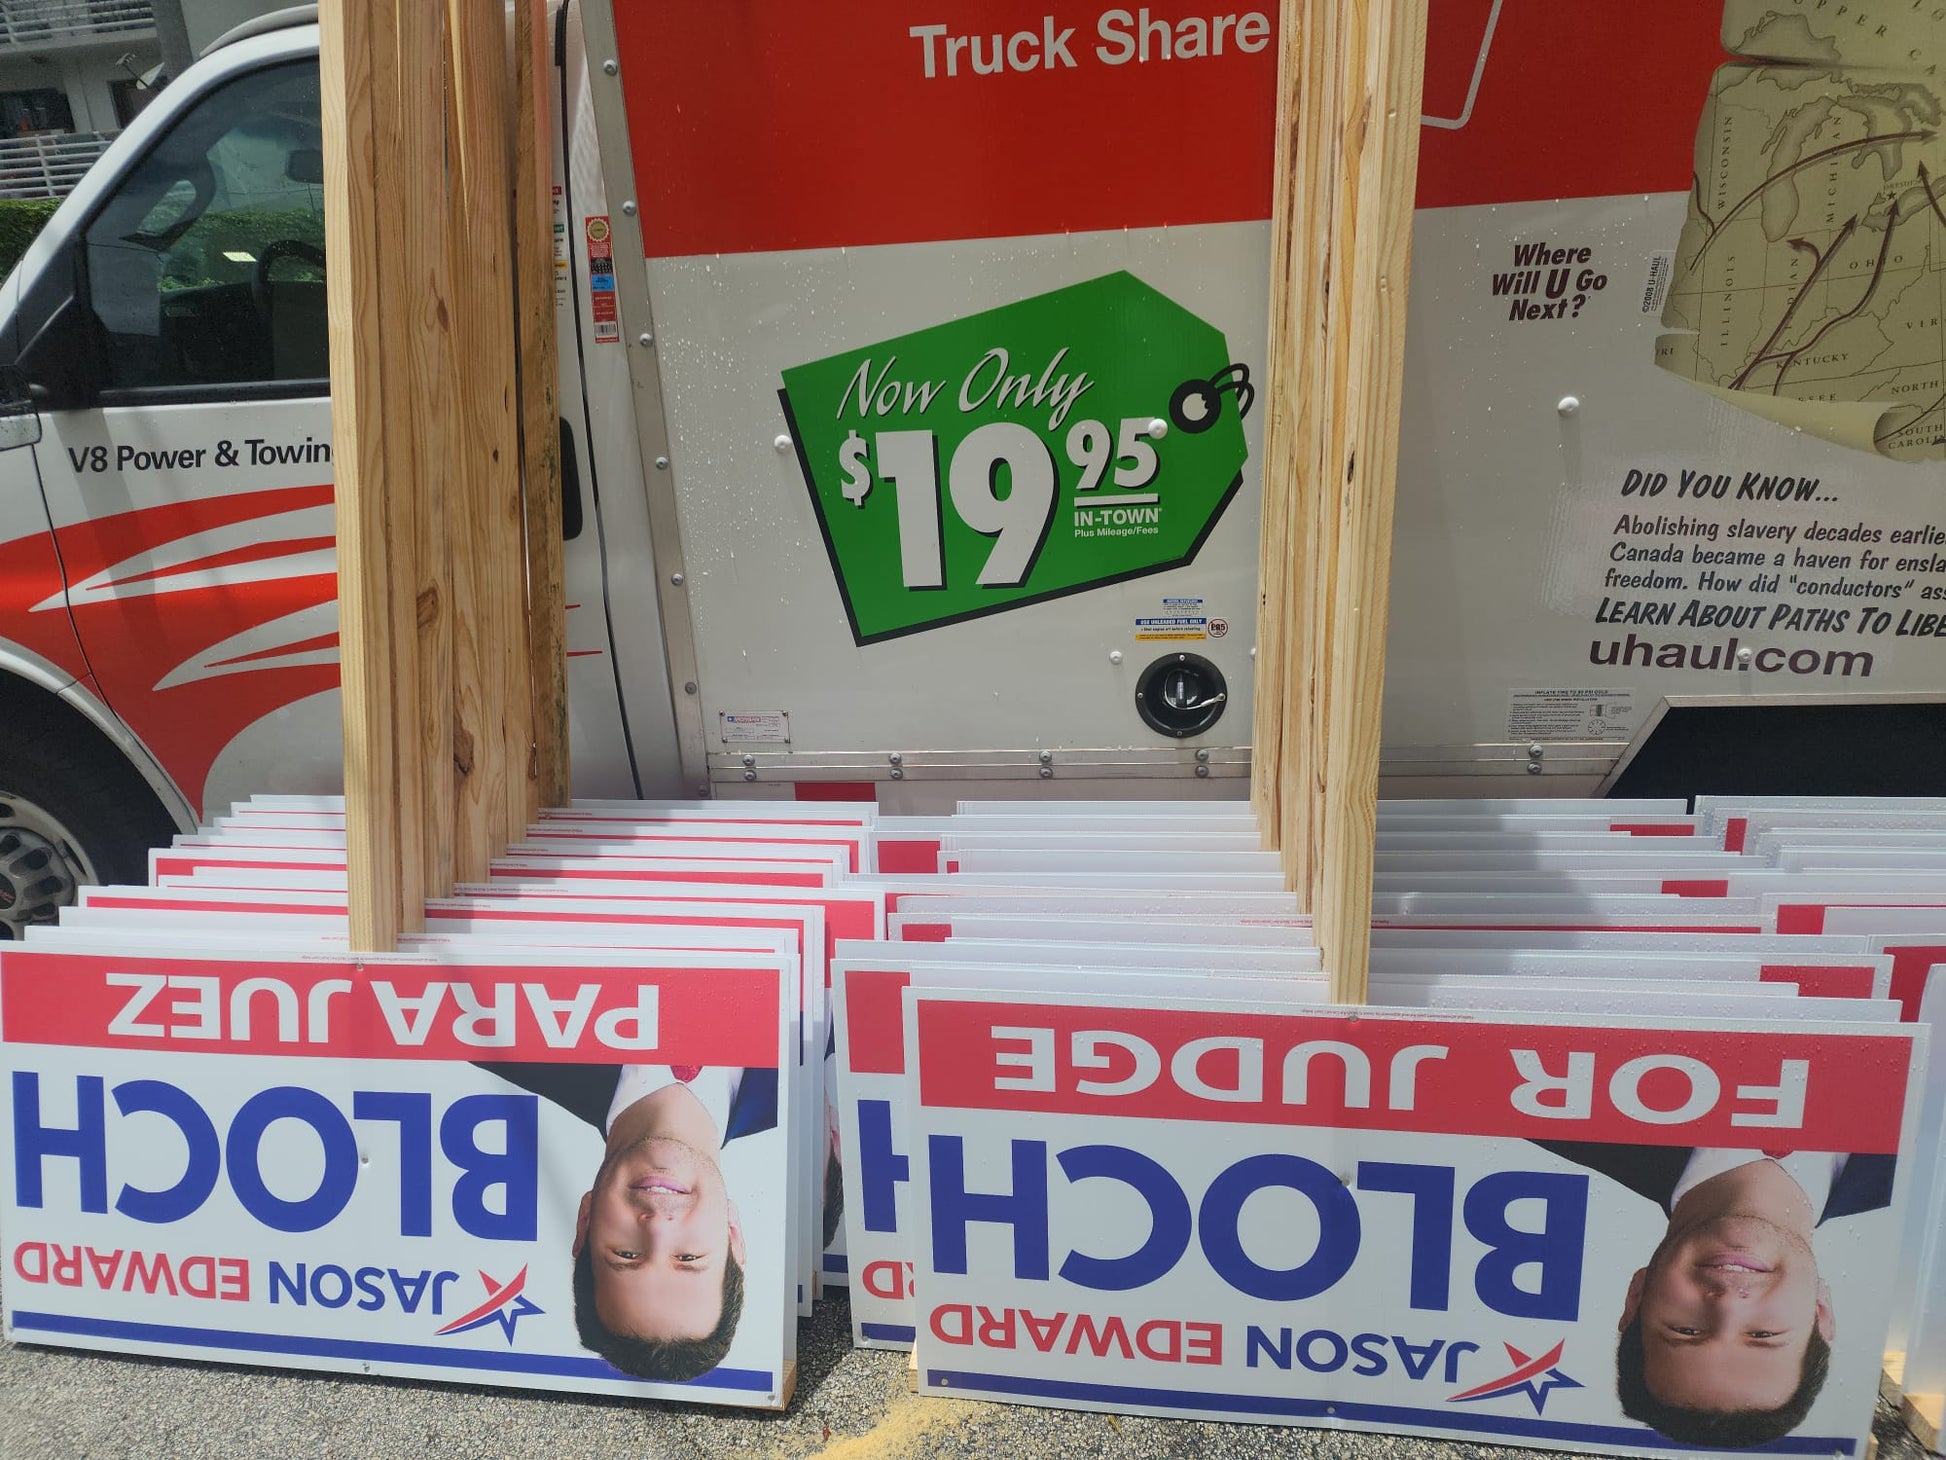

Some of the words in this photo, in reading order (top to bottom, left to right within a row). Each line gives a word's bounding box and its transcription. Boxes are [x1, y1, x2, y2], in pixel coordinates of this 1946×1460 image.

[909, 15, 1079, 79] Truck
[1095, 7, 1271, 66] Share
[1717, 115, 1733, 210] WISCONSIN
[1514, 241, 1592, 267] Where
[1492, 270, 1542, 296] Will
[1545, 268, 1572, 299] U
[1576, 269, 1608, 292] Go
[1719, 254, 1735, 347] ILLINOIS
[837, 355, 947, 420] Now
[958, 346, 1095, 432] Only
[1775, 353, 1849, 370] KNTUCKY
[1891, 380, 1939, 395] NORTH
[67, 445, 108, 473] V8
[116, 445, 207, 472] Power
[214, 439, 241, 468] &
[244, 436, 334, 466] Towin
[1065, 417, 1161, 491] 95
[1621, 469, 1668, 497] DID
[1677, 469, 1732, 499] YOU
[1074, 508, 1161, 527] IN-TOWN
[1074, 529, 1095, 538] Plus
[1096, 526, 1159, 538] Mileage/Fees
[1613, 514, 1720, 542] Abolishing
[1726, 518, 1797, 545] slavery
[1803, 520, 1883, 544] decades
[1889, 524, 1946, 546] earlie
[1604, 567, 1688, 590] freedom.
[1698, 571, 1742, 592] How
[1748, 573, 1781, 594] did
[1789, 574, 1916, 599] "conductors"
[1609, 541, 1684, 562] Canada
[1692, 544, 1766, 566] became
[1773, 552, 1786, 568] a
[1793, 547, 1852, 569] haven
[1859, 549, 1890, 571] for
[1595, 596, 1677, 626] LEARN
[1677, 599, 1768, 630] ABOUT
[1768, 603, 1851, 634] PATHS
[1856, 606, 1893, 635] TO
[1589, 632, 1874, 677] uhaul.com
[105, 972, 354, 1046] JUEZ
[370, 978, 660, 1052] PARA
[992, 1024, 1452, 1114] JUDGE
[1510, 1047, 1811, 1131] FOR
[12, 1070, 540, 1242] BLOCH
[928, 1133, 1591, 1324] BLOCH
[13, 1240, 251, 1303] EDWARD
[267, 1260, 461, 1316] JASON
[928, 1302, 1224, 1368] EDWARD
[1244, 1325, 1480, 1386] JASON
